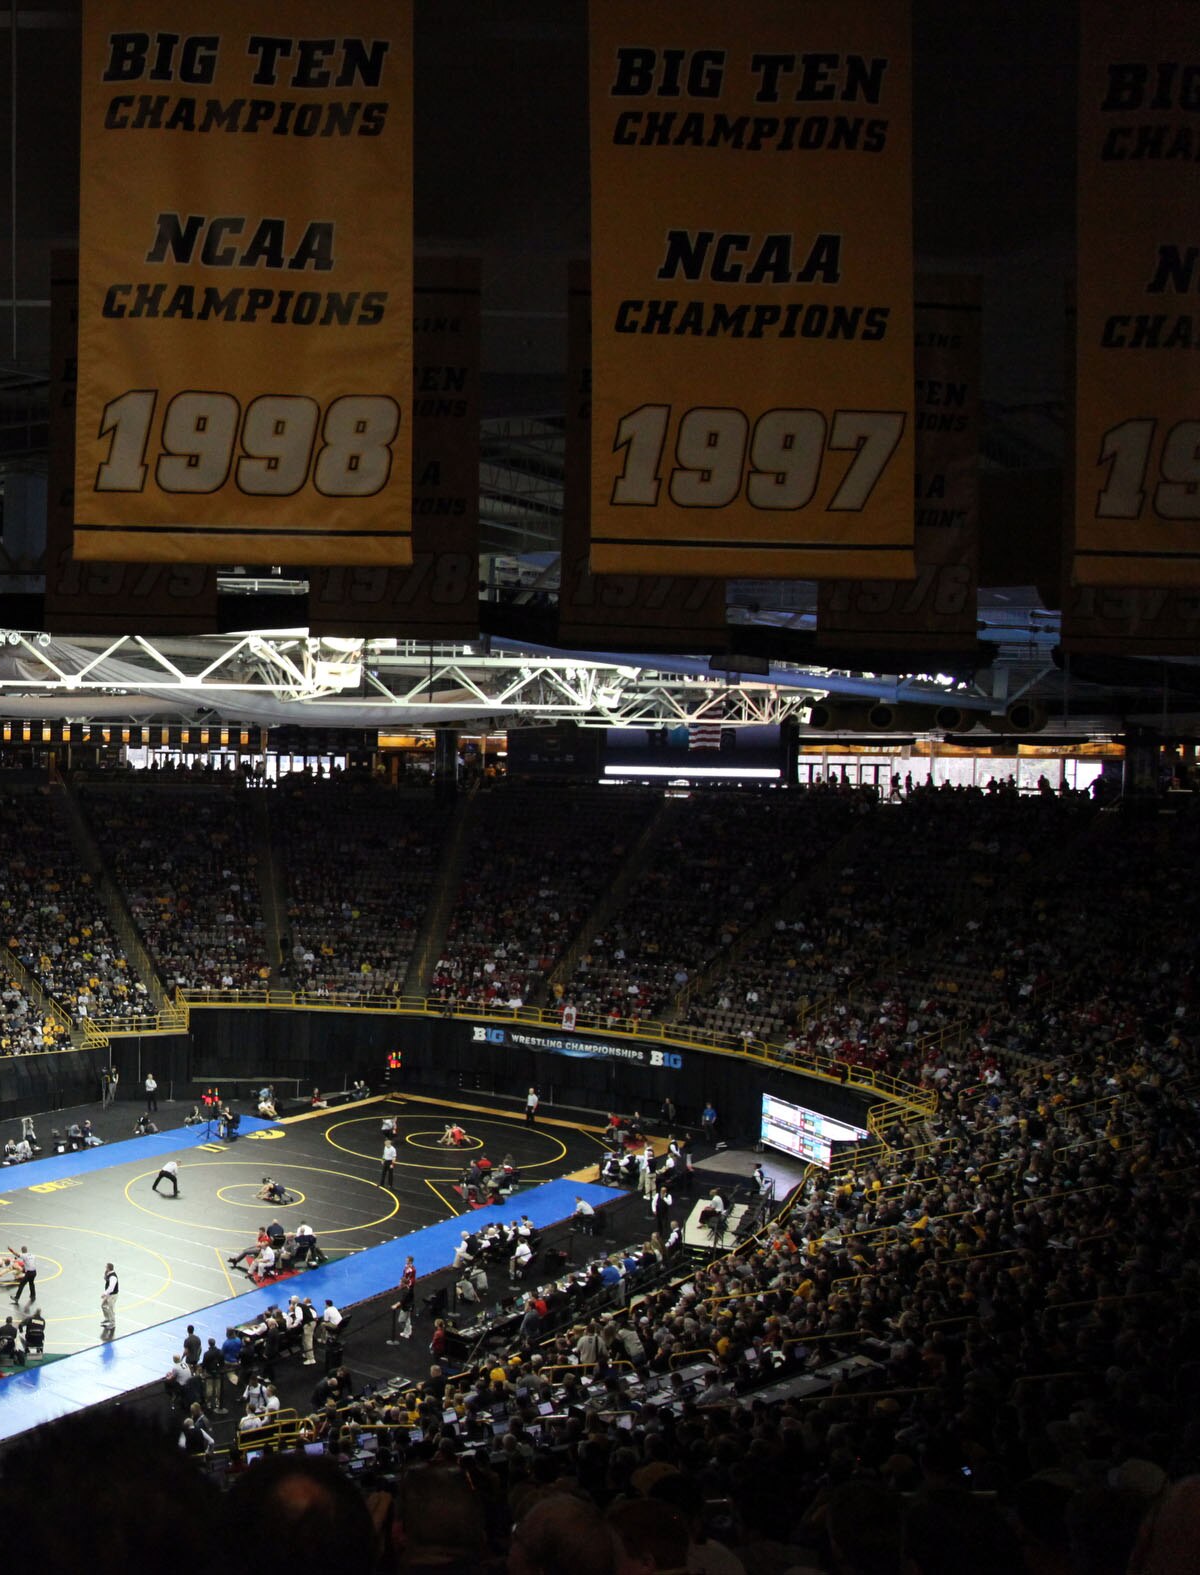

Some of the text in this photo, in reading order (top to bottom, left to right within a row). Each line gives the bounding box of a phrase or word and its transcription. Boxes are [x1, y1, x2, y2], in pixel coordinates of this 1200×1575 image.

[102, 32, 390, 88] BIG TEN
[611, 48, 888, 104] BIG TEN
[104, 95, 389, 138] CHAMPIONS
[613, 111, 890, 153] CHAMPIONS
[145, 212, 335, 272] NCAA
[657, 230, 842, 285] NCAA
[101, 284, 389, 326] CHAMPIONS
[613, 301, 891, 341] CHAMPIONS
[94, 389, 400, 497] 1998
[610, 404, 907, 512] 1997
[511, 1033, 563, 1049] WRESTLING
[565, 1042, 644, 1060] CHAMPIONSHIPS
